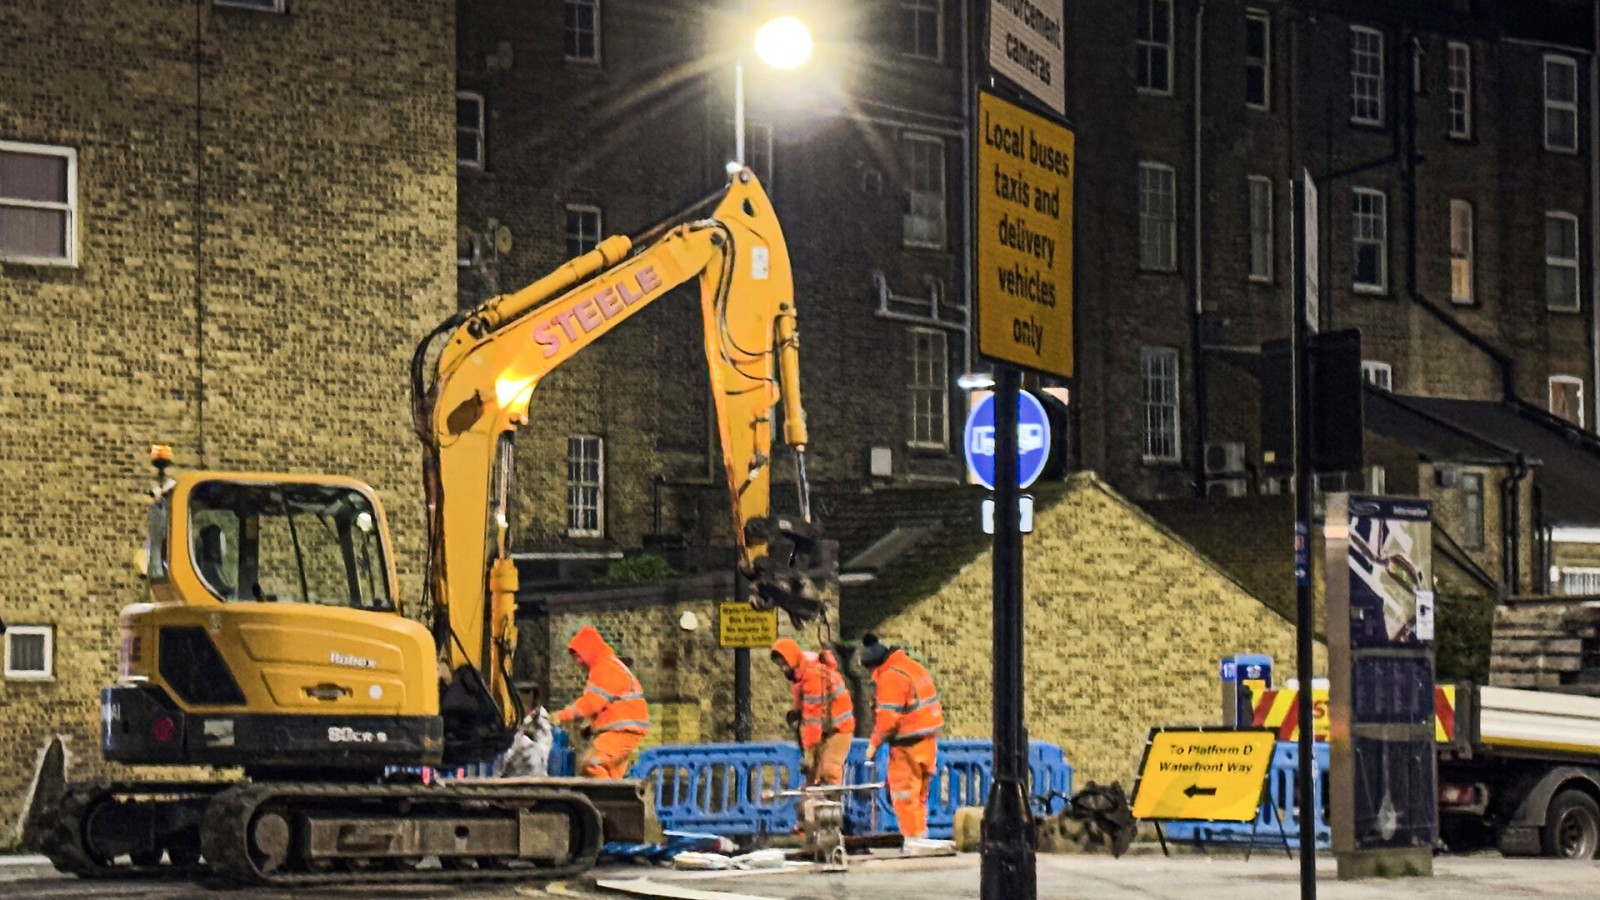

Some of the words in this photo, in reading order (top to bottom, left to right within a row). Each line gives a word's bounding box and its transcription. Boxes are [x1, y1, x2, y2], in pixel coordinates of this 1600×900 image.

[1006, 32, 1051, 86] cameras
[985, 110, 1025, 160] Local
[1029, 129, 1070, 178] buses
[994, 163, 1030, 208] taxis
[1034, 186, 1059, 219] and
[998, 212, 1055, 269] delivery
[533, 265, 663, 359] STEELE
[998, 263, 1056, 308] vehicles
[1013, 315, 1043, 356] only
[1160, 761, 1224, 772] Waterfront
[1227, 761, 1254, 774] Way
[1171, 745, 1184, 754] To
[1188, 744, 1239, 756] Platform
[1243, 744, 1253, 754] D
